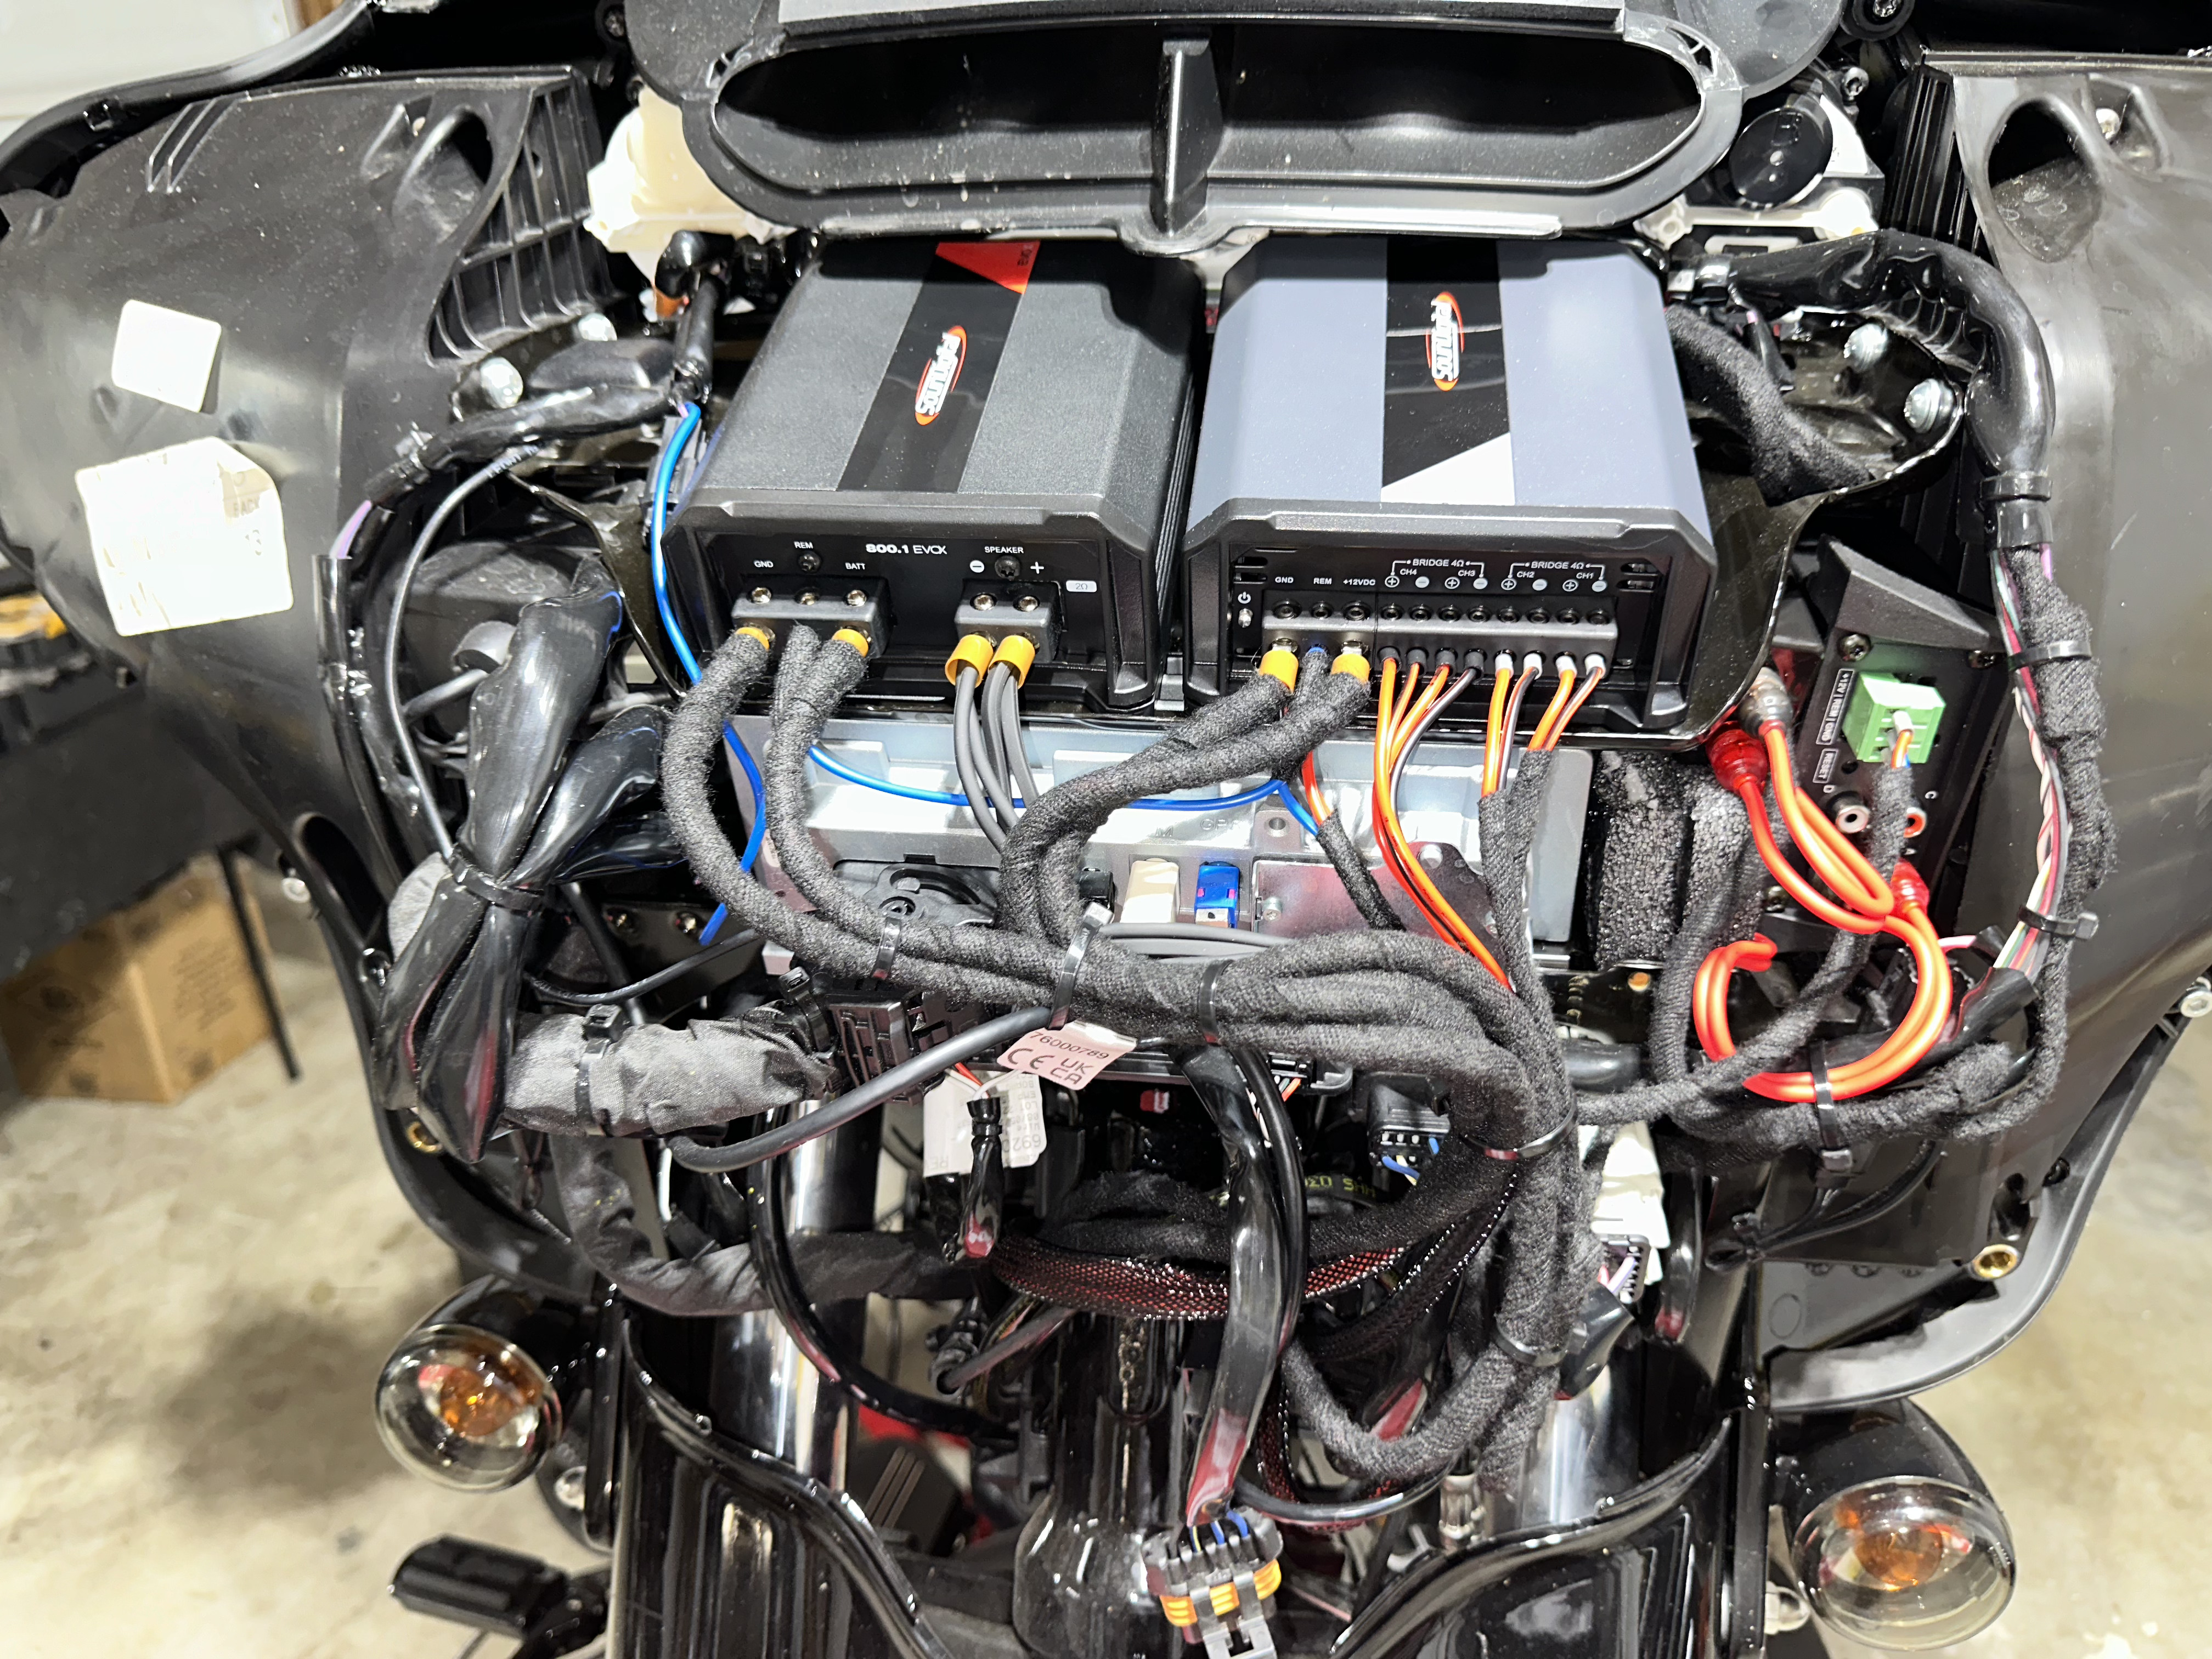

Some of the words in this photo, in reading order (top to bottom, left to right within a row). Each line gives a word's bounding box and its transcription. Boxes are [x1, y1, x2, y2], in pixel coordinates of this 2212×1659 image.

[794, 541, 813, 549] REM
[865, 543, 910, 554] 800.1
[984, 546, 1024, 555] SPEAKER
[753, 560, 774, 568] GND
[845, 562, 866, 570] BATT
[1412, 558, 1449, 567] BRIDGE
[1531, 561, 1569, 569] BRIDGE
[1818, 752, 1835, 780] RESET
[1029, 1031, 1109, 1059] 76000789
[1060, 1058, 1095, 1075] UK
